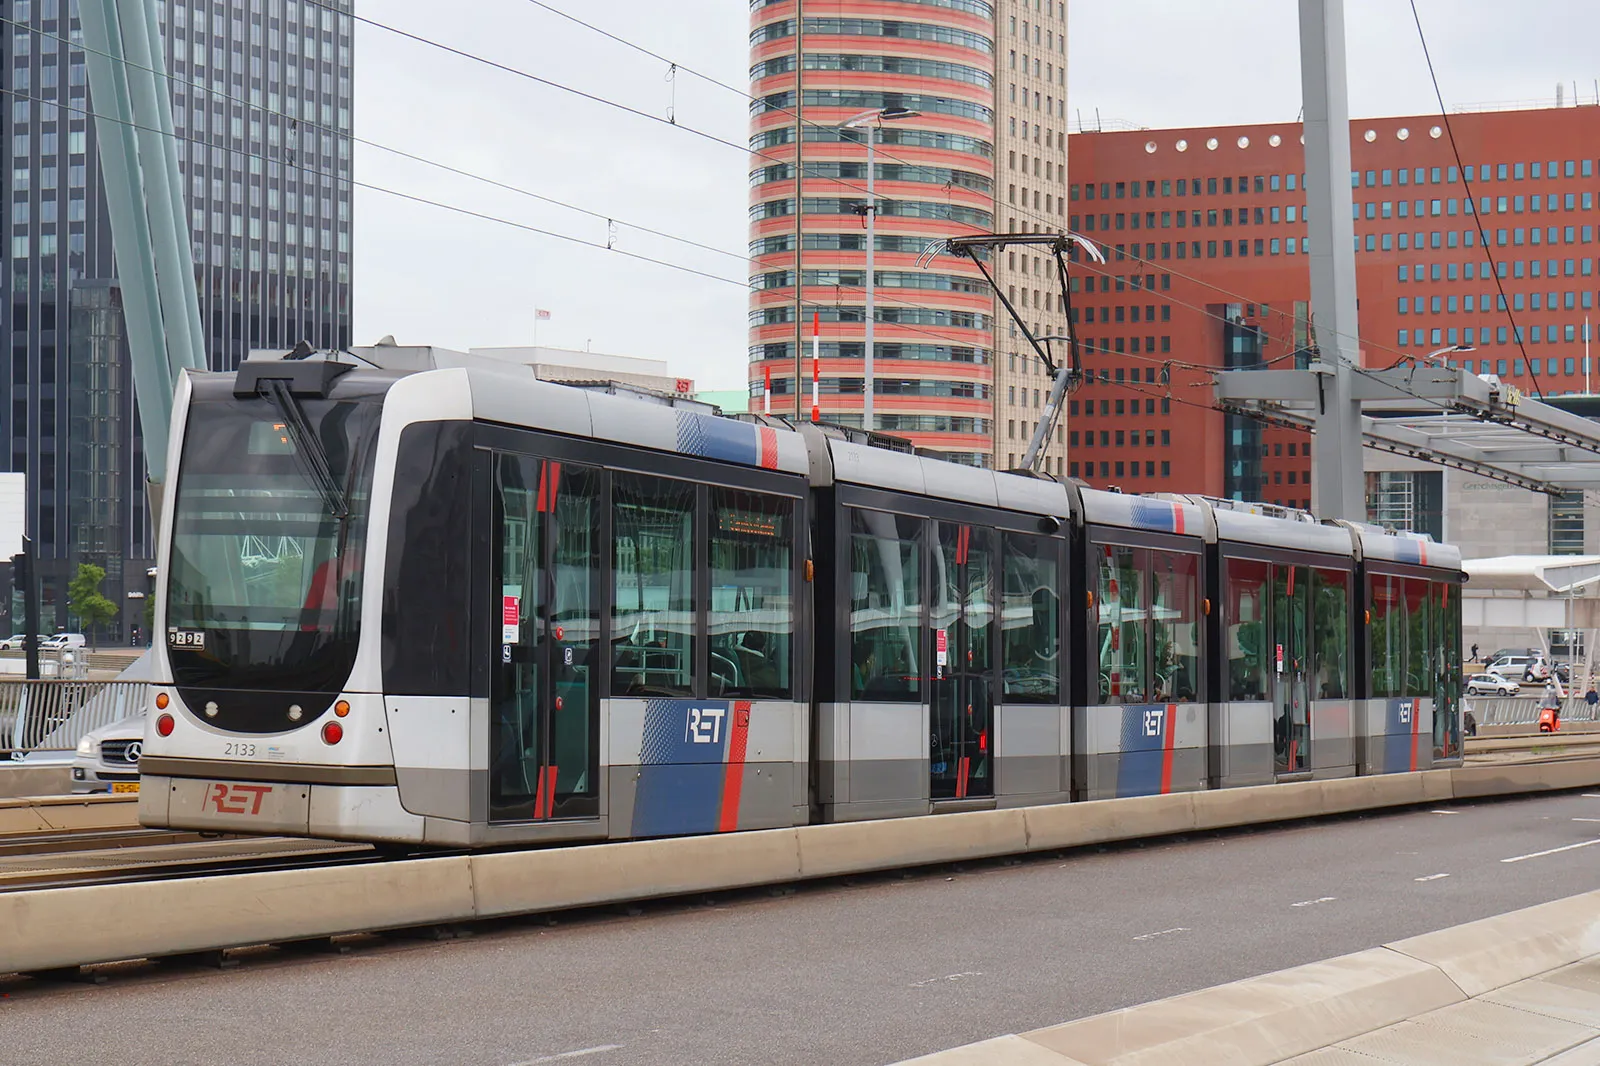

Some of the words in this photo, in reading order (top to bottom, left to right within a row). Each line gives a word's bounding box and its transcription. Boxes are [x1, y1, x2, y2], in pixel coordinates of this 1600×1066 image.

[170, 633, 203, 644] 9292
[1142, 710, 1164, 736] RET
[1398, 703, 1411, 723] RET
[685, 708, 725, 743] RET
[224, 742, 256, 757] 2133
[202, 783, 273, 815] RET
